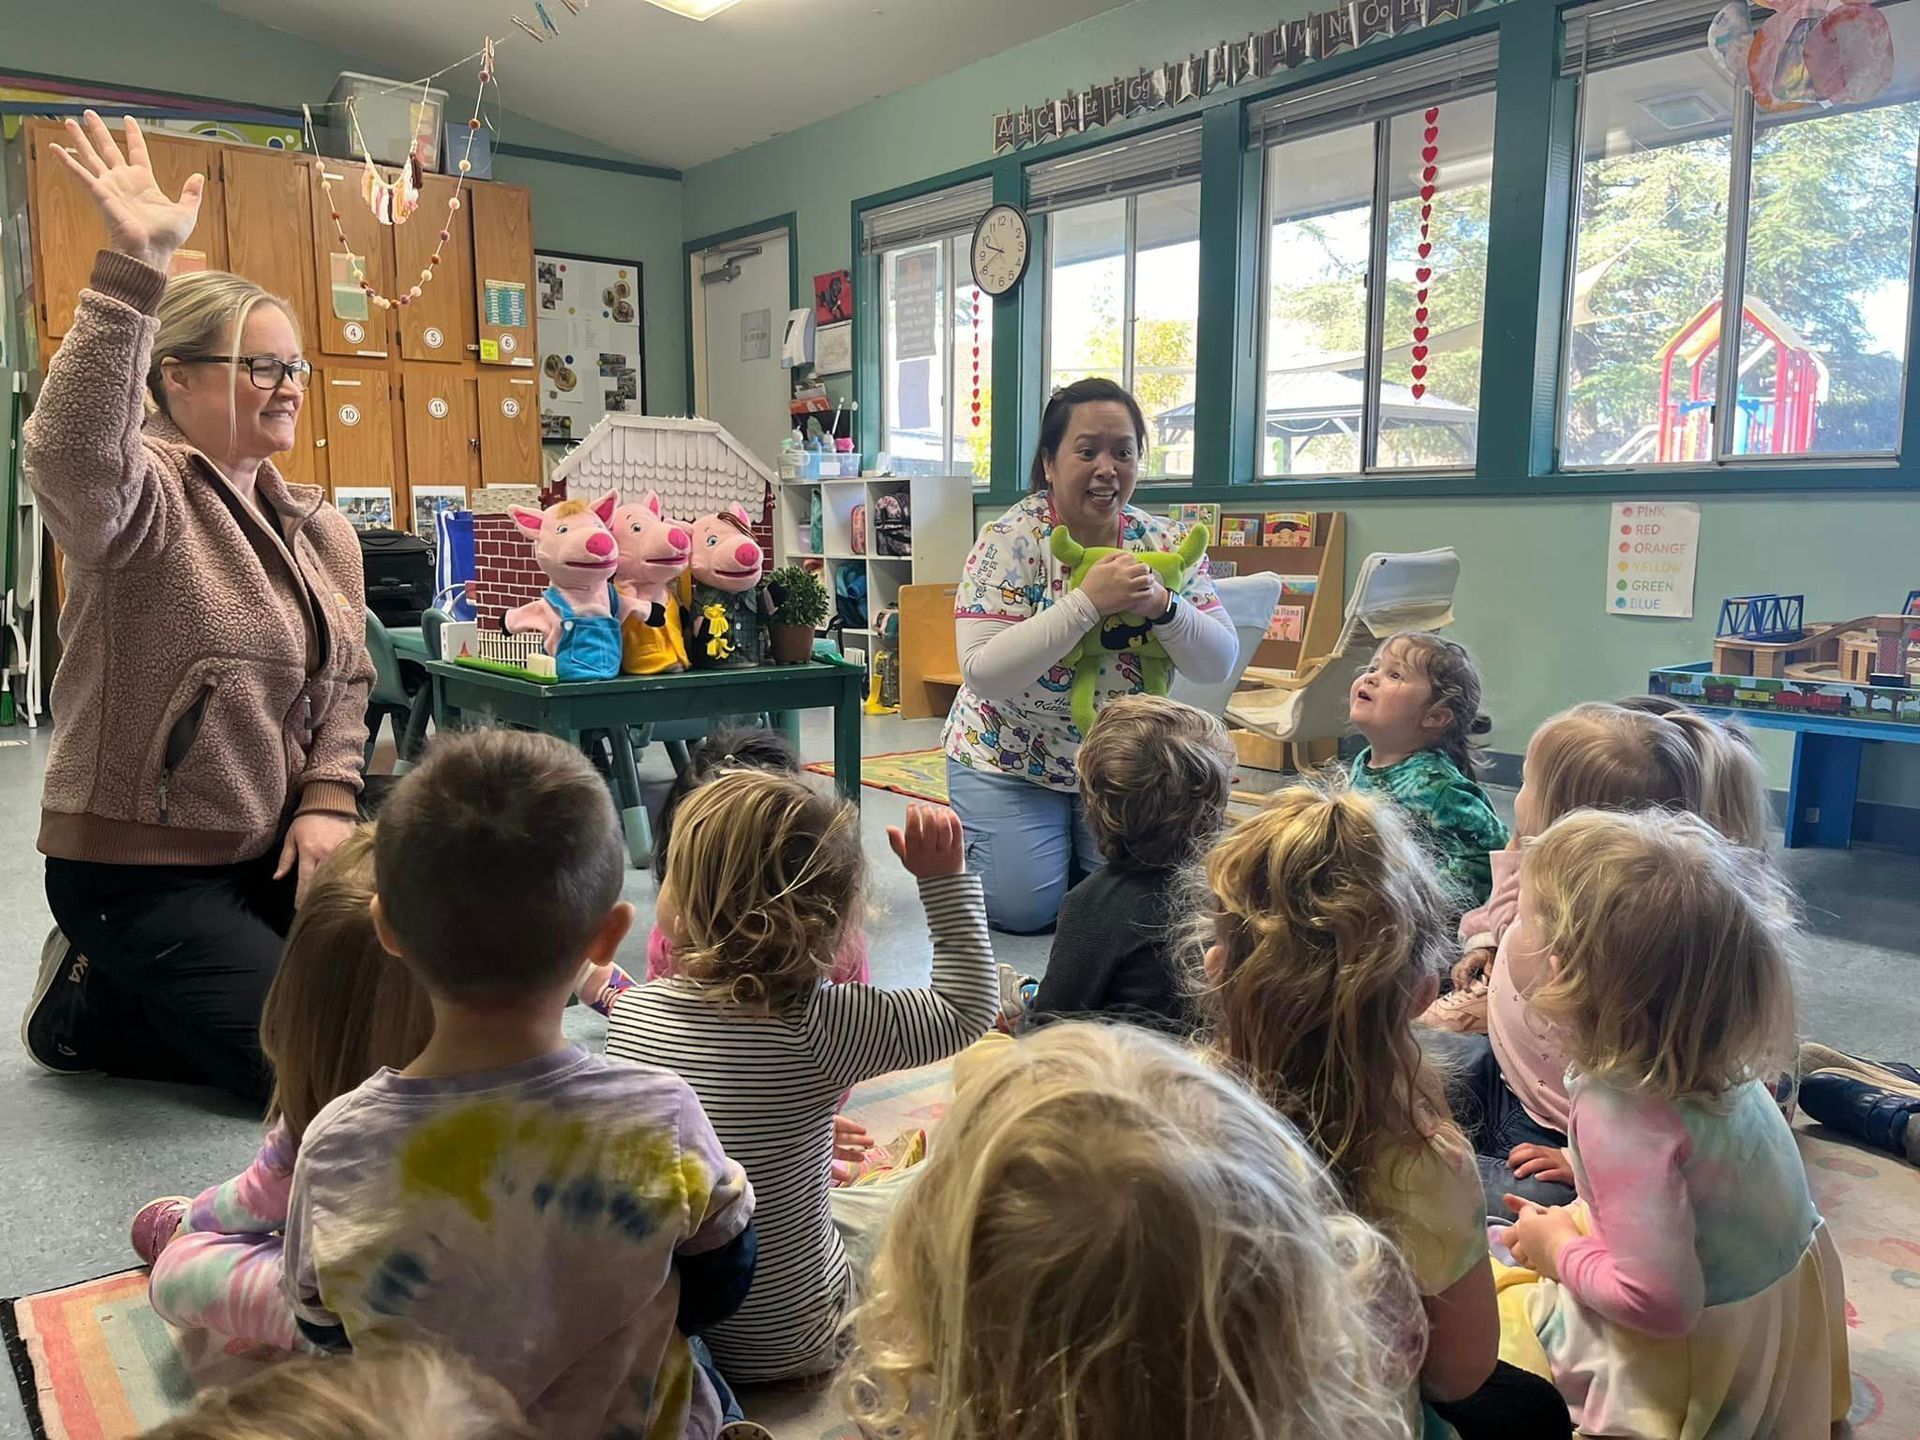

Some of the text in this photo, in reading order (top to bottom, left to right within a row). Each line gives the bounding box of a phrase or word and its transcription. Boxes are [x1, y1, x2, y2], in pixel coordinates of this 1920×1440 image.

[1017, 113, 1033, 136] Bb
[1061, 99, 1077, 123] Dd
[1085, 94, 1098, 116] Ee
[1129, 78, 1150, 101] Gg
[1363, 2, 1390, 26] Oo
[998, 215, 1006, 226] 12
[989, 223, 996, 233] 11
[1015, 228, 1022, 239] 2
[1018, 242, 1024, 252] 3
[980, 251, 986, 261] 9
[1015, 257, 1021, 267] 4
[982, 265, 989, 276] 8
[1008, 271, 1015, 281] 5
[989, 275, 995, 285] 7
[998, 277, 1005, 287] 6
[433, 402, 442, 413] 11
[505, 402, 515, 413] 12
[344, 410, 355, 421] 10
[1636, 505, 1666, 518] PINK
[1635, 524, 1661, 535] RED
[1634, 542, 1688, 554] ORANGE
[1632, 561, 1682, 574] YELLOW
[1631, 579, 1674, 592] GREEN
[1630, 598, 1662, 610] BLUE
